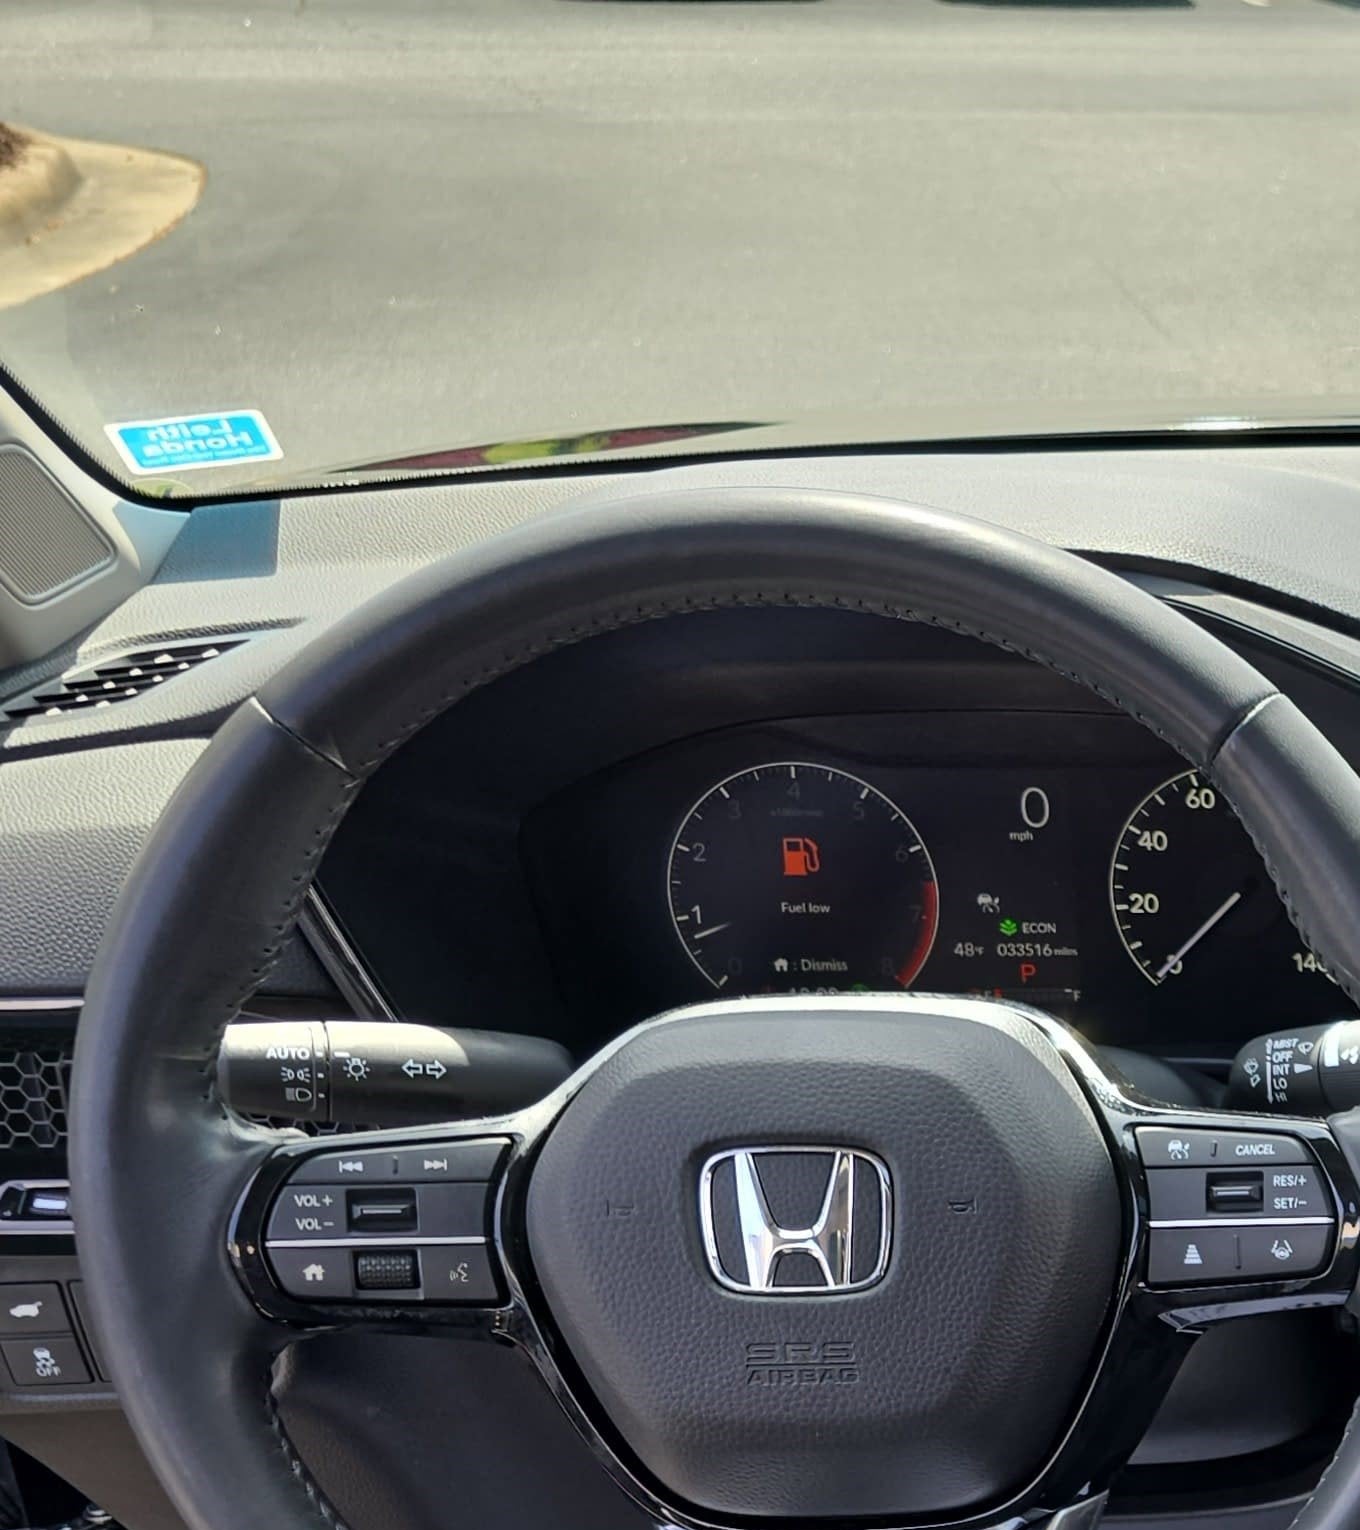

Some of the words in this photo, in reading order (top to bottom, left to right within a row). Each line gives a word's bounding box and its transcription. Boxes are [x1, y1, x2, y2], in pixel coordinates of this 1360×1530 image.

[1185, 788, 1215, 809] 60
[1020, 786, 1050, 828] 0
[1009, 831, 1034, 842] mph
[1138, 831, 1168, 852] 40
[693, 843, 706, 862] 2
[781, 902, 806, 913] Fuel
[808, 902, 830, 913] low
[1129, 893, 1159, 914] 20
[692, 905, 702, 924] 1
[1022, 922, 1056, 934] ECON
[997, 943, 1052, 957] 033516
[801, 958, 848, 972] Dismiss
[1021, 964, 1036, 983] P
[1273, 1038, 1299, 1049] MIST
[266, 1047, 310, 1060] AUTO
[1272, 1050, 1293, 1062] OFF
[1272, 1063, 1291, 1076] INT
[1273, 1078, 1288, 1090] LO
[1235, 1143, 1275, 1156] CANCEL
[1273, 1175, 1307, 1188] RES/+
[746, 1341, 857, 1363] SRS
[36, 1366, 62, 1377] OFF
[746, 1368, 861, 1386] AIRBAG
